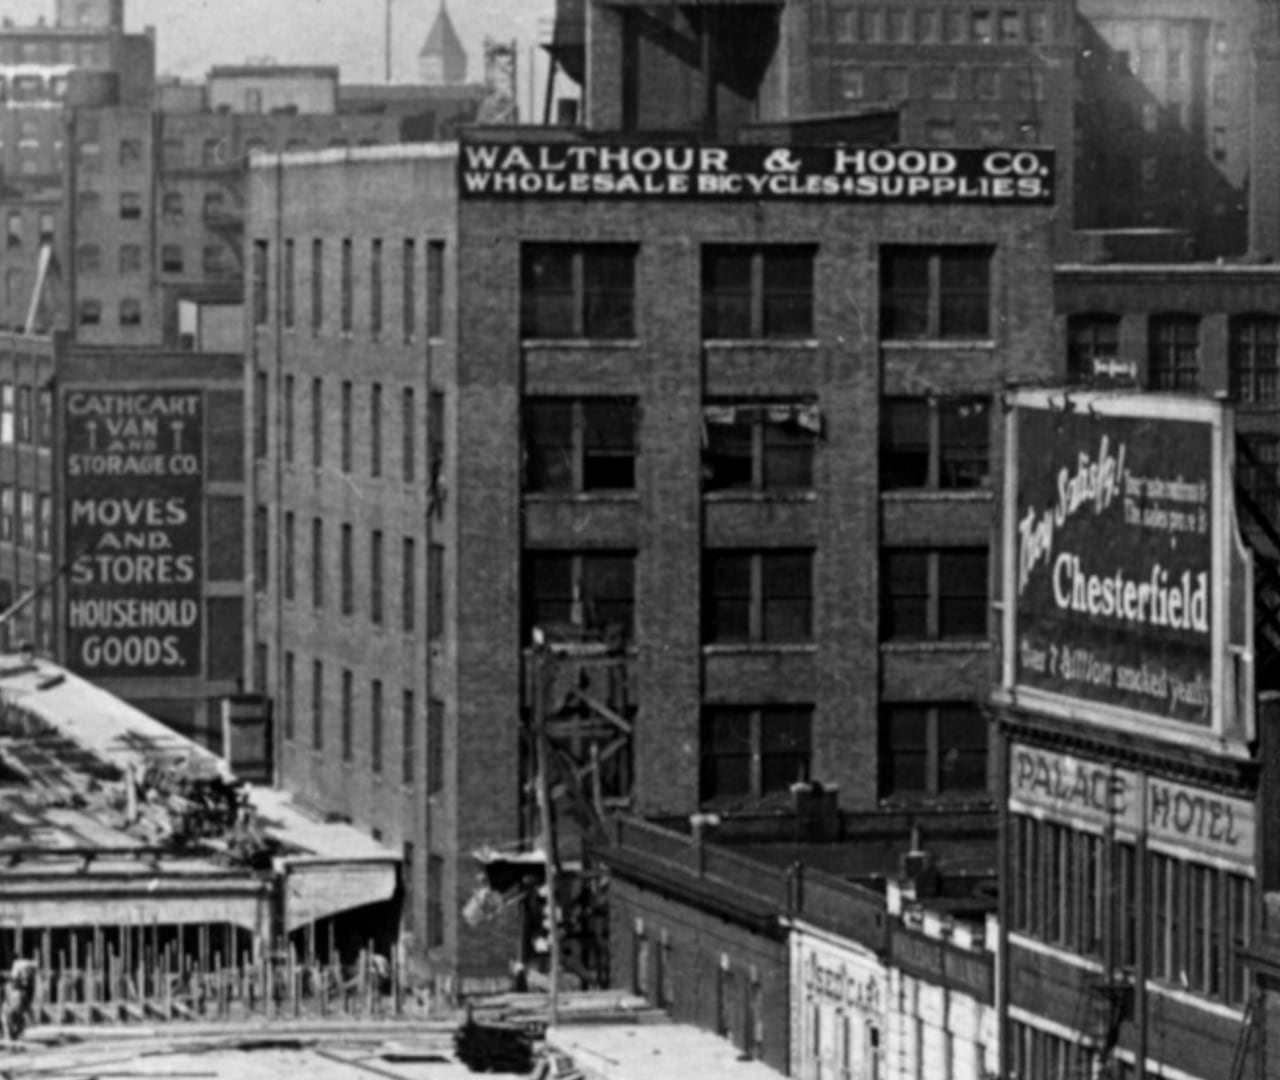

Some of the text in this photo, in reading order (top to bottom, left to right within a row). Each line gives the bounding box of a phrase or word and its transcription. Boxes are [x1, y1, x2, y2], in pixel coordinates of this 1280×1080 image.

[465, 145, 1049, 176] WALTHOUR & HOOD CO.
[463, 172, 696, 195] WHOLESALE
[697, 174, 841, 195] BICYCLES
[855, 175, 1050, 198] SUPPLIES.
[69, 394, 200, 415] CATHCART
[105, 418, 158, 436] VAN
[107, 439, 158, 450] AND
[69, 455, 201, 475] STORAGE CO.
[71, 499, 188, 526] MOVES
[70, 555, 195, 584] STORES
[1053, 551, 1209, 632] Chesterfield
[70, 599, 197, 627] HOUSEHOLD
[81, 636, 186, 667] GOODS.
[1017, 752, 1239, 846] PALACE HOTEL
